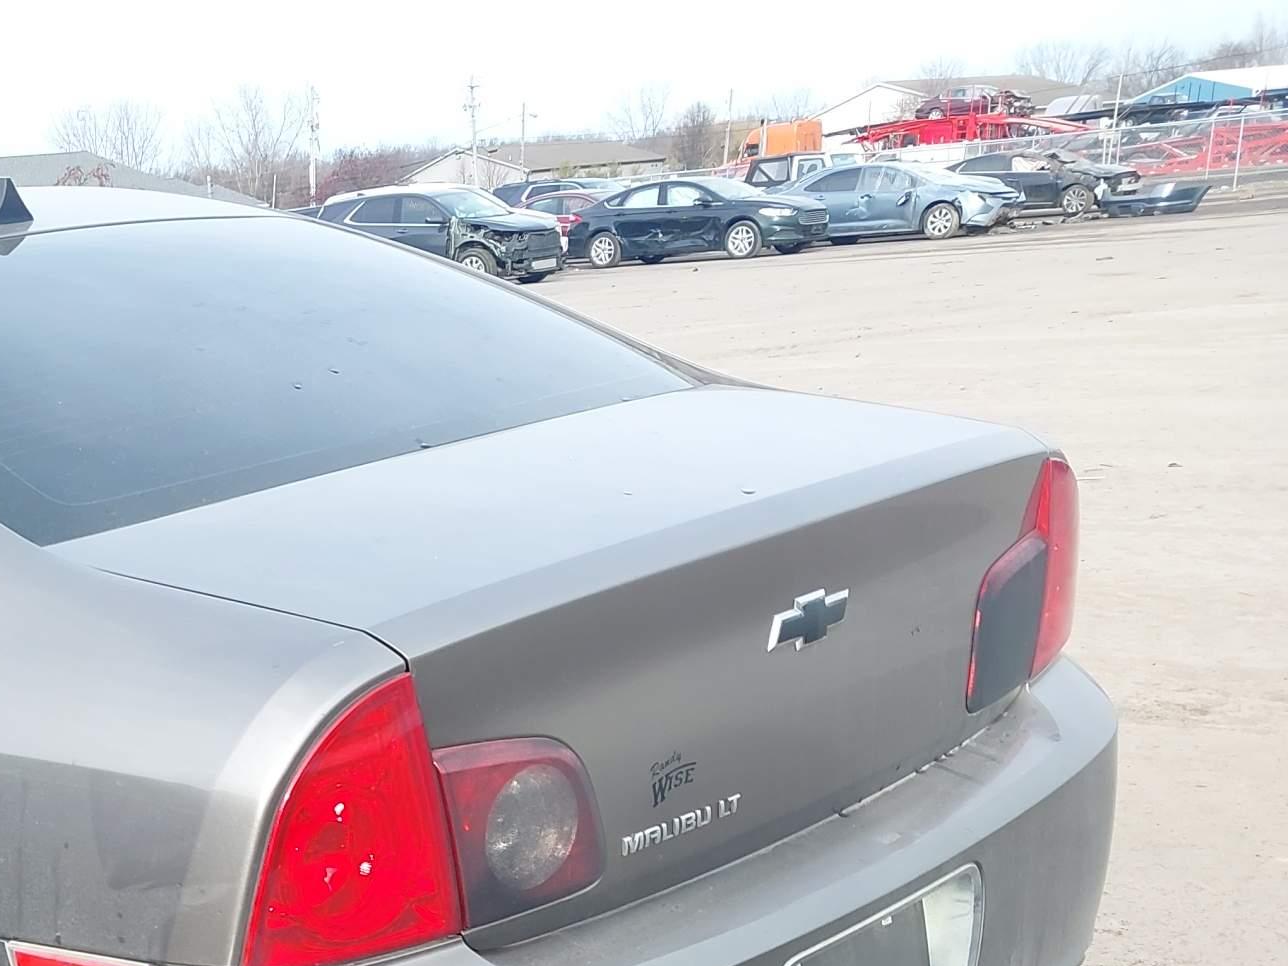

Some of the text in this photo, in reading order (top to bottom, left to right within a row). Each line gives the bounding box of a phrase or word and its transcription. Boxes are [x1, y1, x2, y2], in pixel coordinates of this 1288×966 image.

[652, 763, 696, 808] WISE
[620, 793, 742, 857] MALIBU LT
